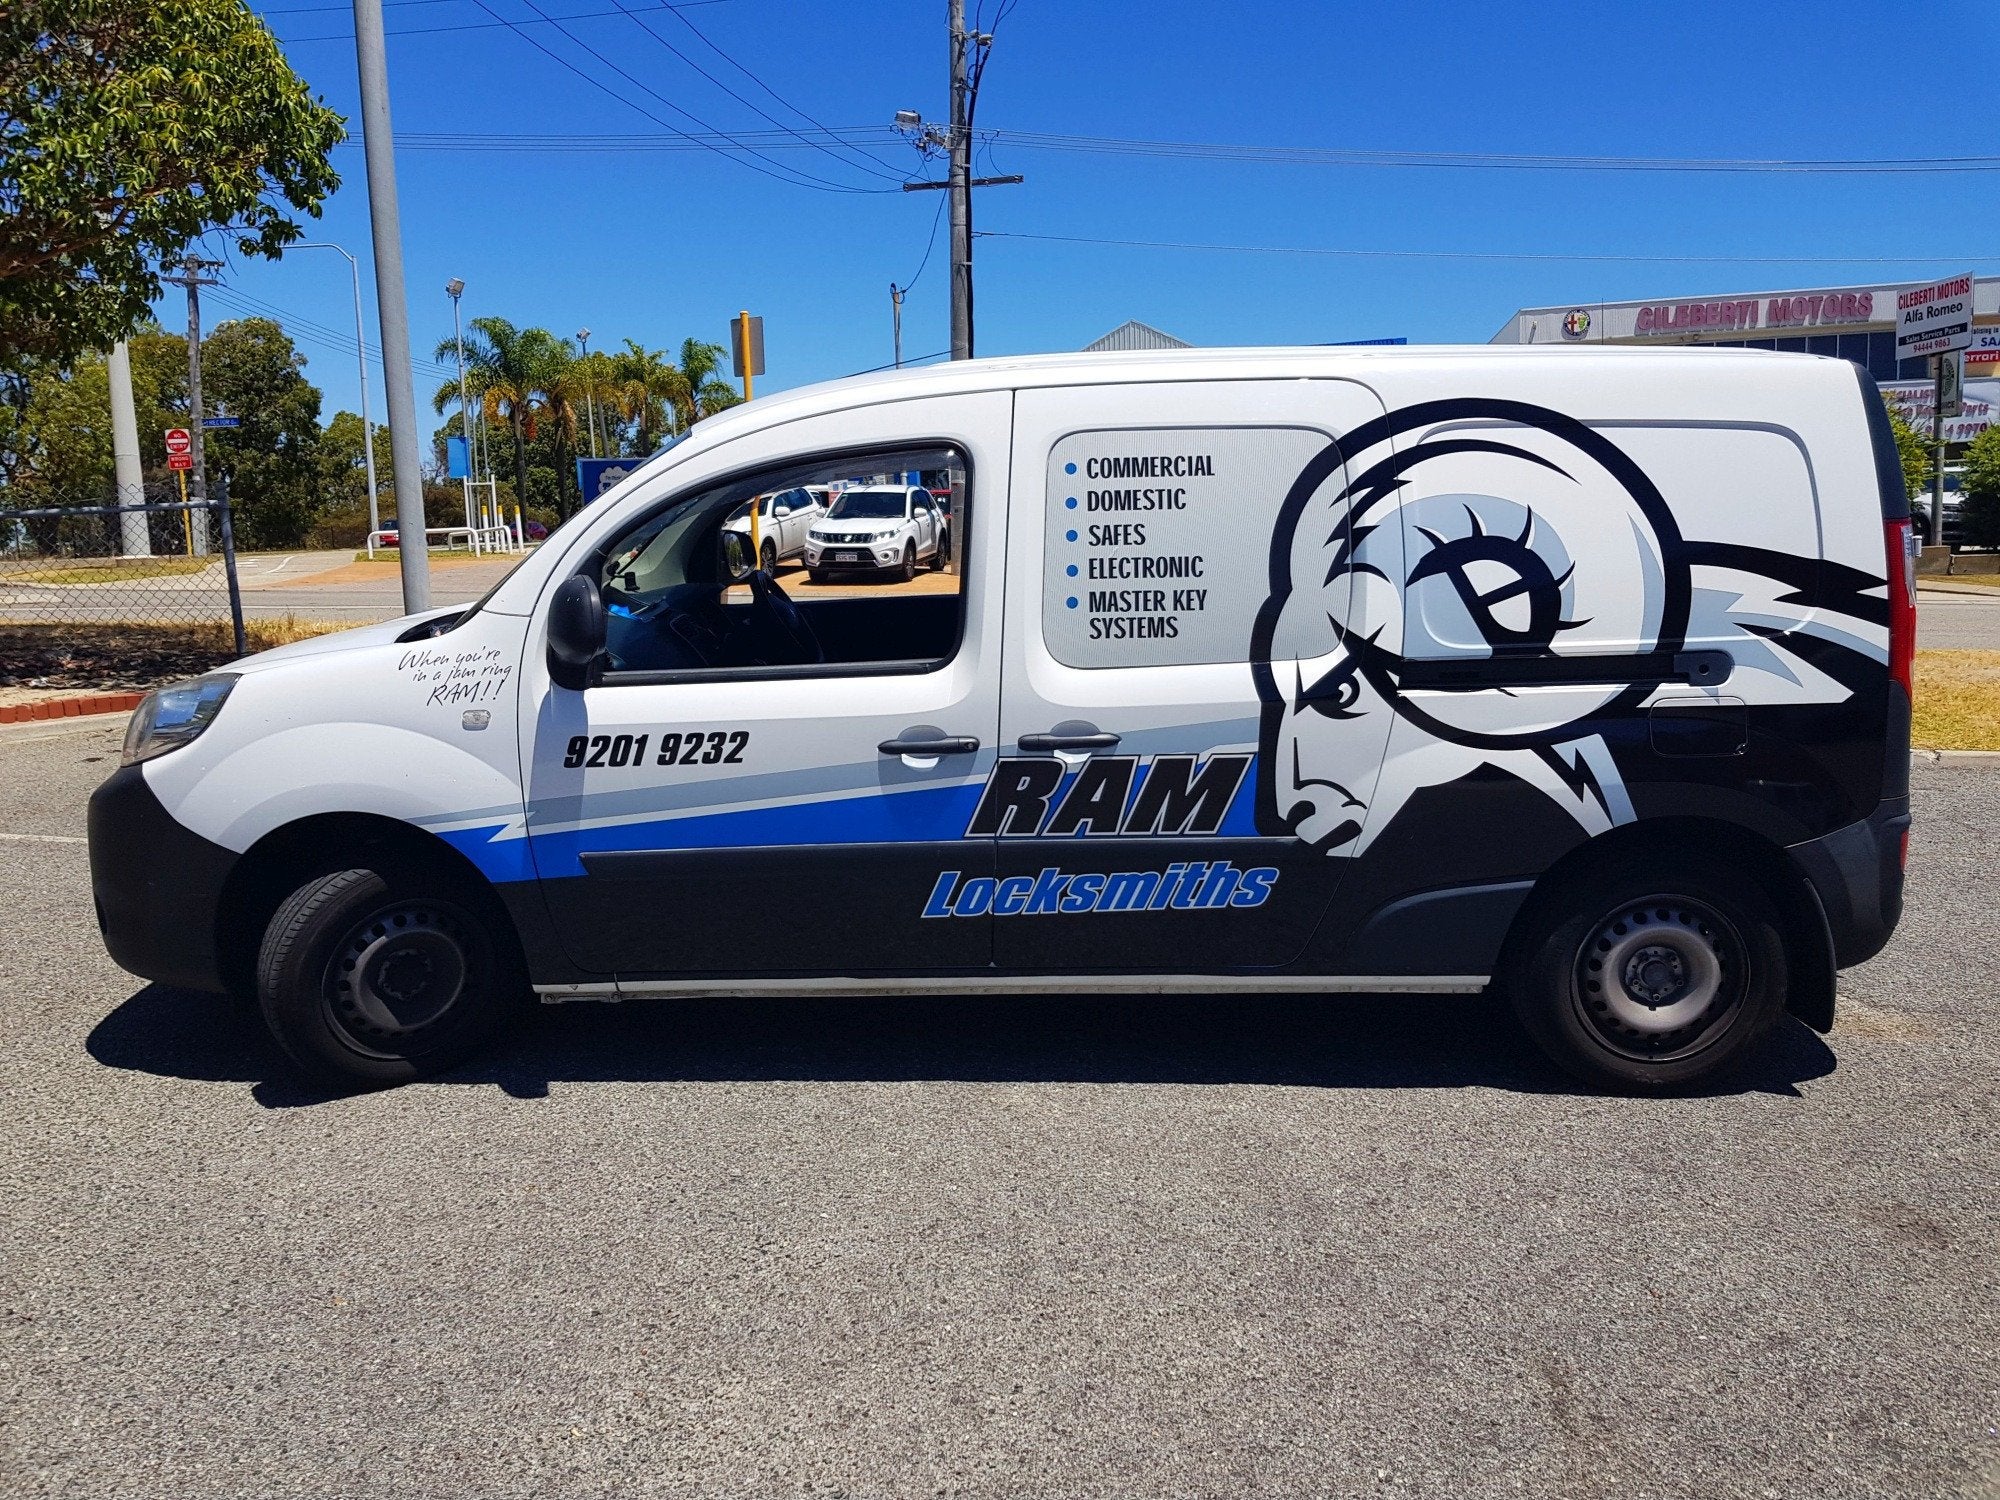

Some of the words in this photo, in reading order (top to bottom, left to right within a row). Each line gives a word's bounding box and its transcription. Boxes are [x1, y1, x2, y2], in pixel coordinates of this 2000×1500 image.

[1937, 277, 1970, 300] MOTORS
[1768, 292, 1873, 322] MOTORS
[1904, 309, 1924, 325] Alfa
[1926, 302, 1963, 319] Romeo
[1905, 335, 1920, 343] Sales
[1921, 330, 1943, 340] Service
[1944, 326, 1961, 336] Parts
[1980, 337, 2000, 347] SA
[1964, 350, 1999, 362] errari
[1086, 455, 1215, 479] COMMERCIAL
[1087, 488, 1187, 511] DOMESTIC
[1088, 524, 1146, 546] SAFES
[1088, 555, 1204, 579] ELECTRONIC
[1089, 590, 1166, 612] MASTER
[1172, 589, 1208, 611] KEY
[1089, 616, 1179, 639] SYSTEMS
[398, 650, 449, 670] When
[456, 645, 501, 669] you're
[412, 669, 427, 681] in
[432, 670, 442, 681] a
[444, 665, 475, 685] jam
[481, 662, 512, 682] ring
[426, 680, 505, 706] RAM!!
[563, 734, 650, 769] 9201
[656, 731, 750, 766] 9232
[963, 753, 1256, 839] RAM
[921, 860, 1280, 918] Locksmiths
